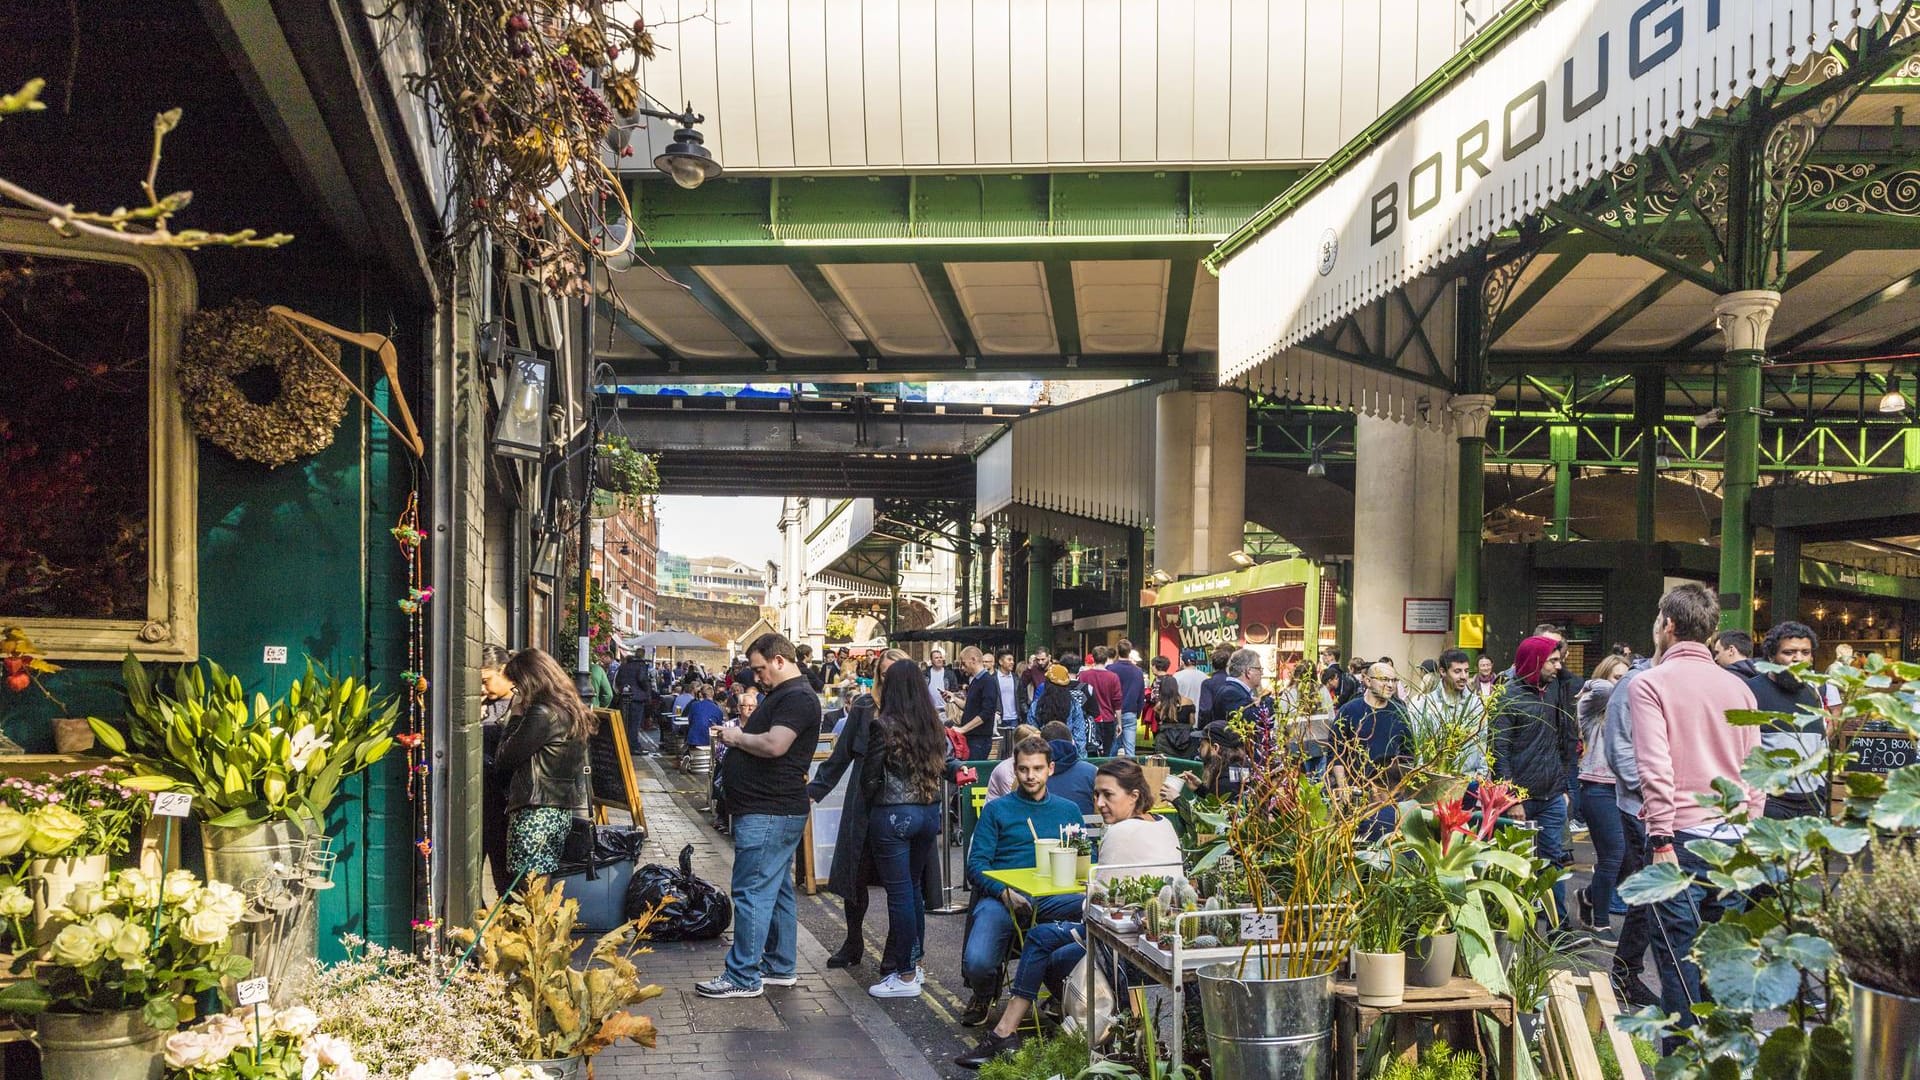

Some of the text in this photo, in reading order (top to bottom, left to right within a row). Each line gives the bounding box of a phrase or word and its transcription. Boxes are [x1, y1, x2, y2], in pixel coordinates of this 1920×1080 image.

[1371, 0, 1721, 246] BOROUG
[1181, 601, 1221, 627] Paul
[1179, 623, 1240, 648] Wheeler
[1875, 738, 1887, 752] 3
